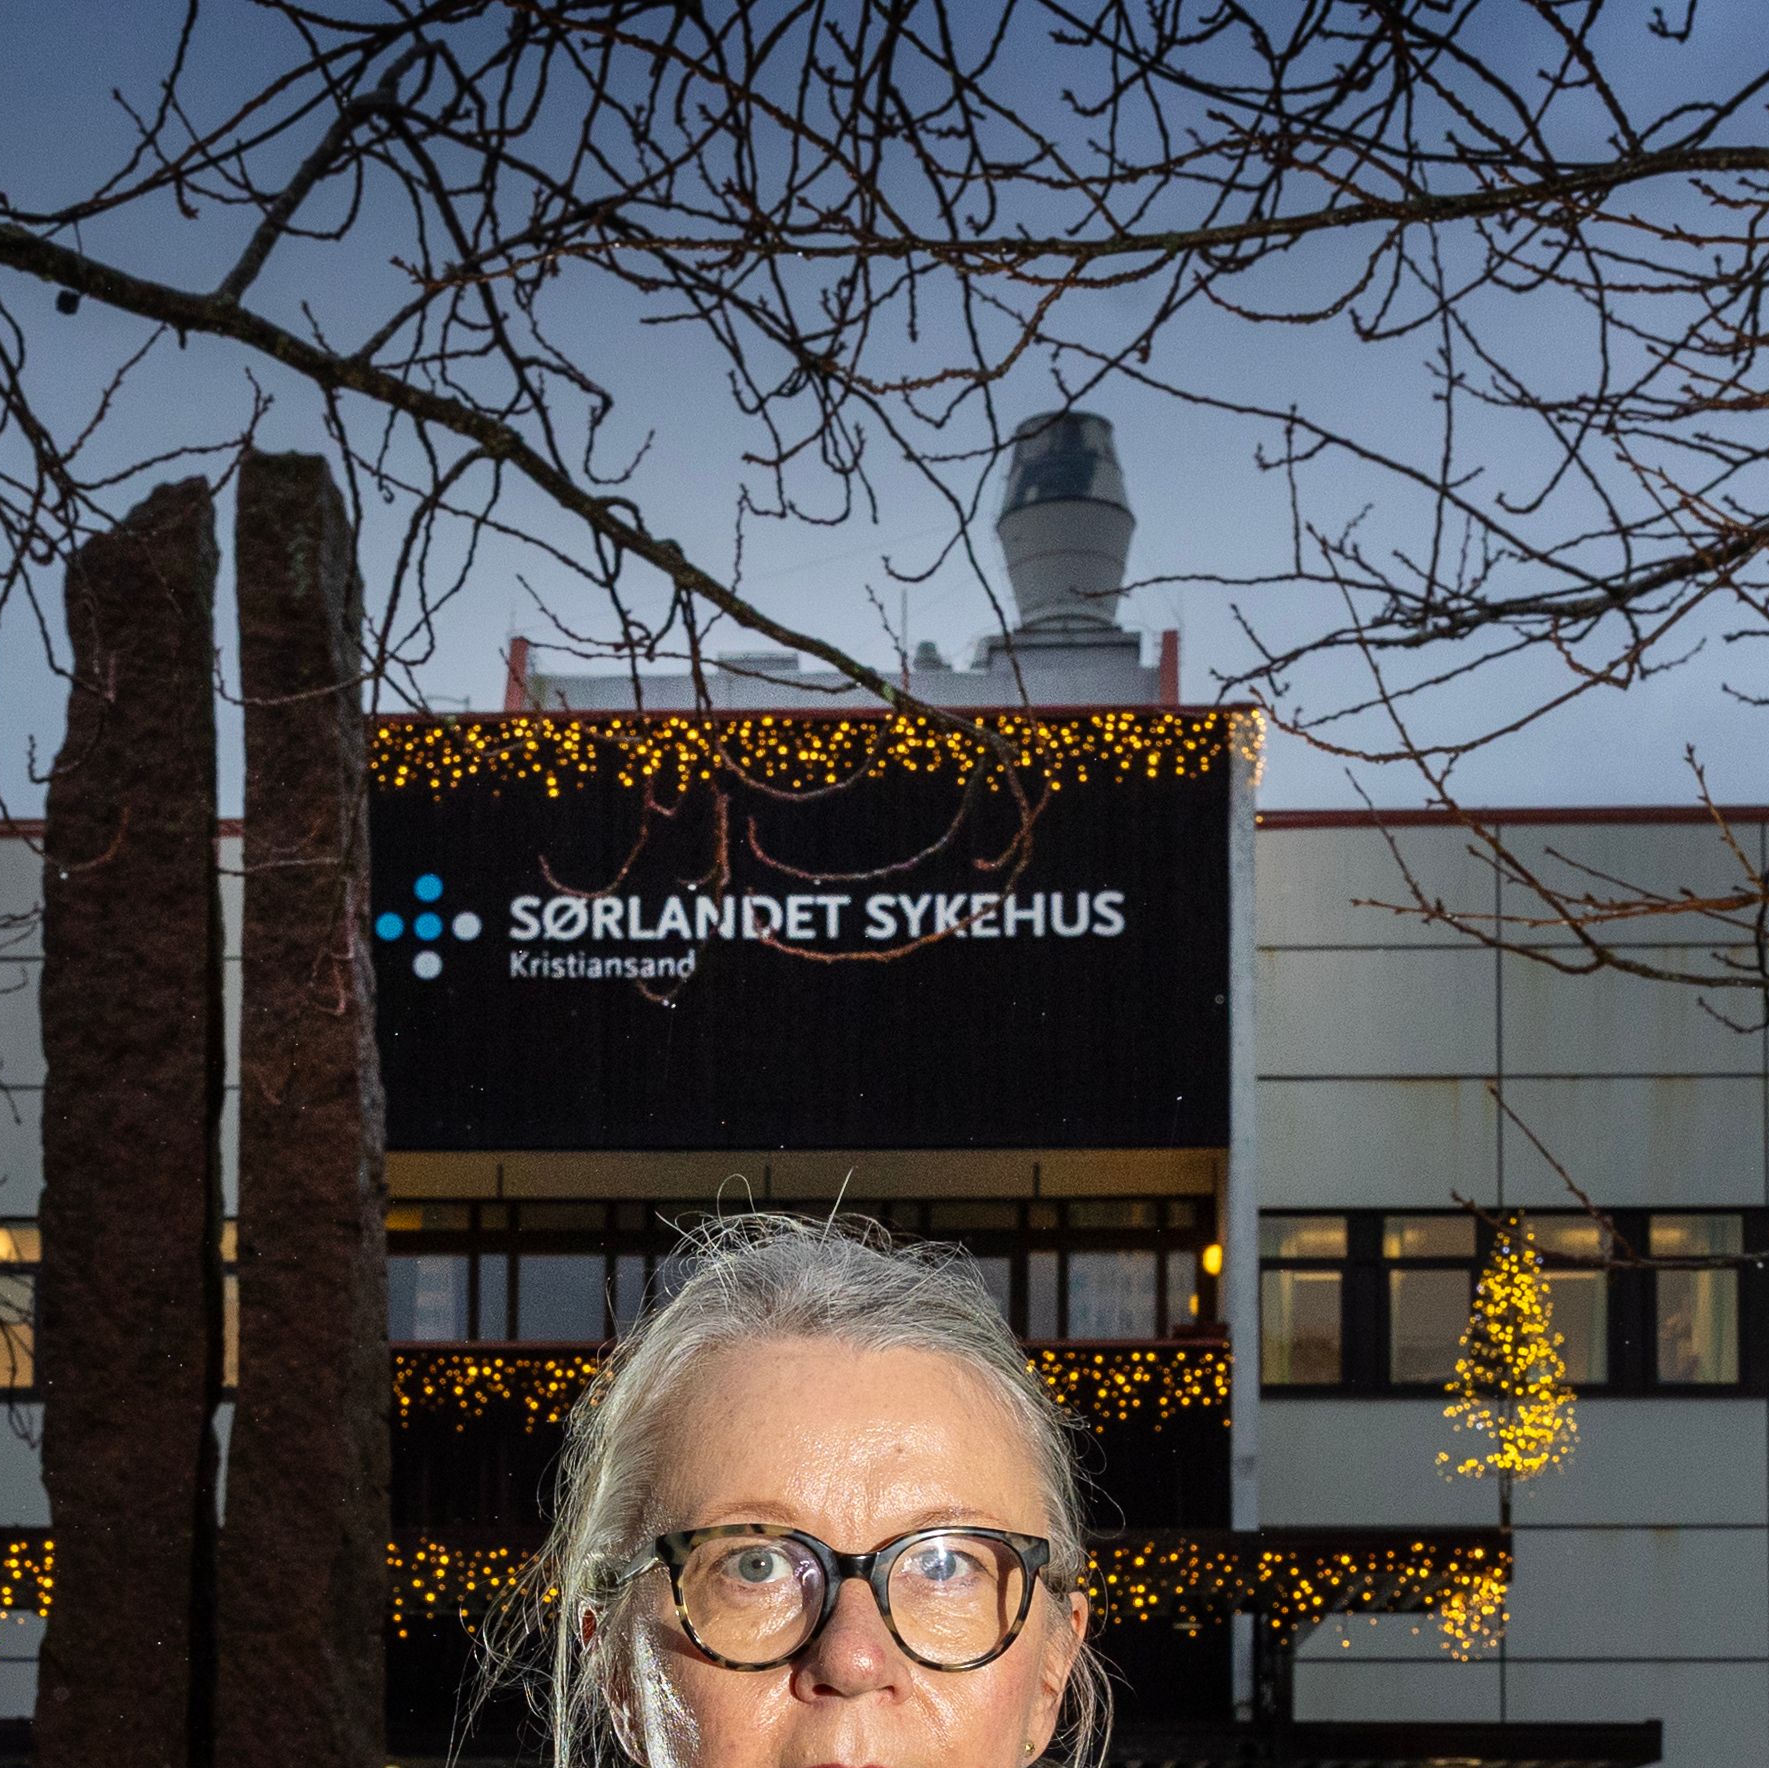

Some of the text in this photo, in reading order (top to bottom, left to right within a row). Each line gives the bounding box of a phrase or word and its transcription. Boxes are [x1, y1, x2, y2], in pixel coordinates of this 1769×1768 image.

[508, 891, 1127, 944] SØRLANDET SYKEHUS
[509, 950, 697, 979] Kristiansand
